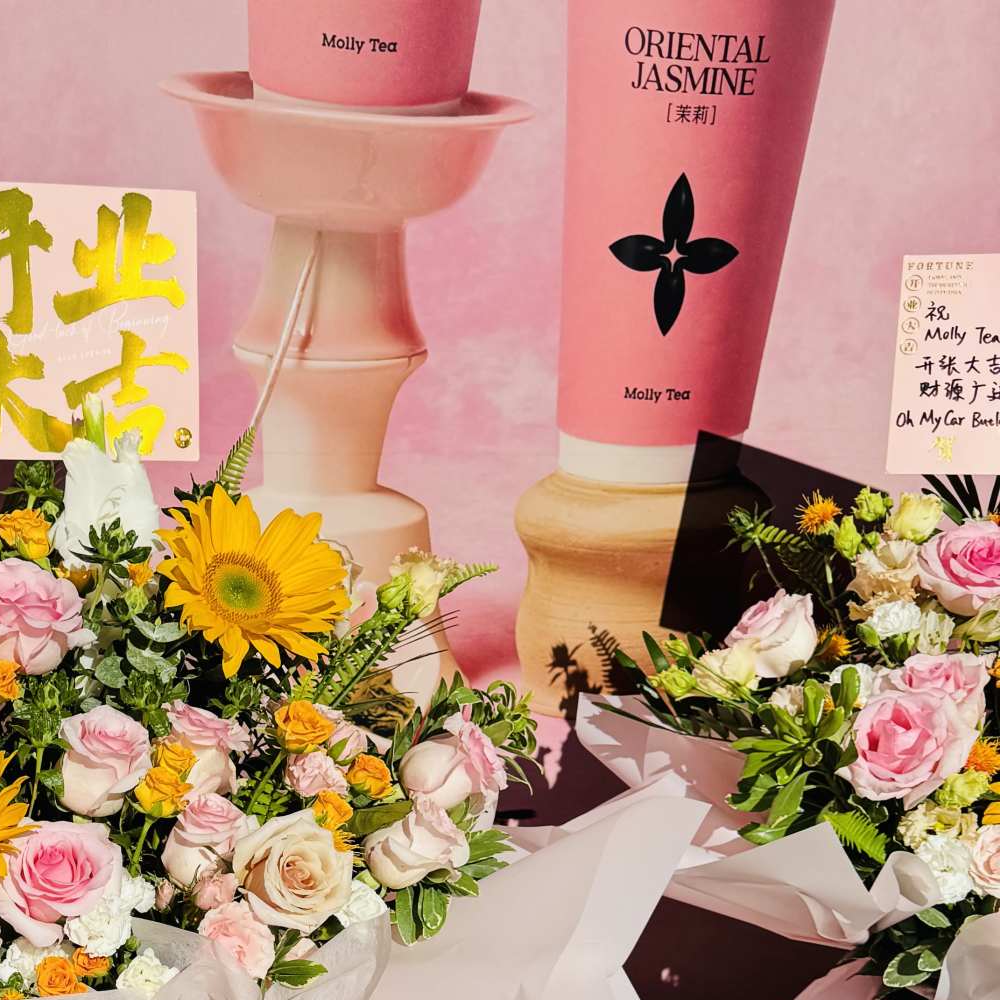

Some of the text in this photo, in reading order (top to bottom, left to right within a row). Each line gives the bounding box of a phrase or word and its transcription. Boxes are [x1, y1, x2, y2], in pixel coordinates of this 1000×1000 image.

[321, 32, 398, 55] Molly Tea
[624, 26, 772, 64] ORIENTAL
[631, 61, 758, 96] JASMINE
[907, 260, 974, 272] FORTUNE
[924, 302, 950, 322] 祝
[924, 325, 967, 346] Molly
[623, 386, 691, 404] Molly Tea
[896, 410, 914, 428] Oh
[919, 409, 942, 434] My
[943, 409, 966, 427] Car
